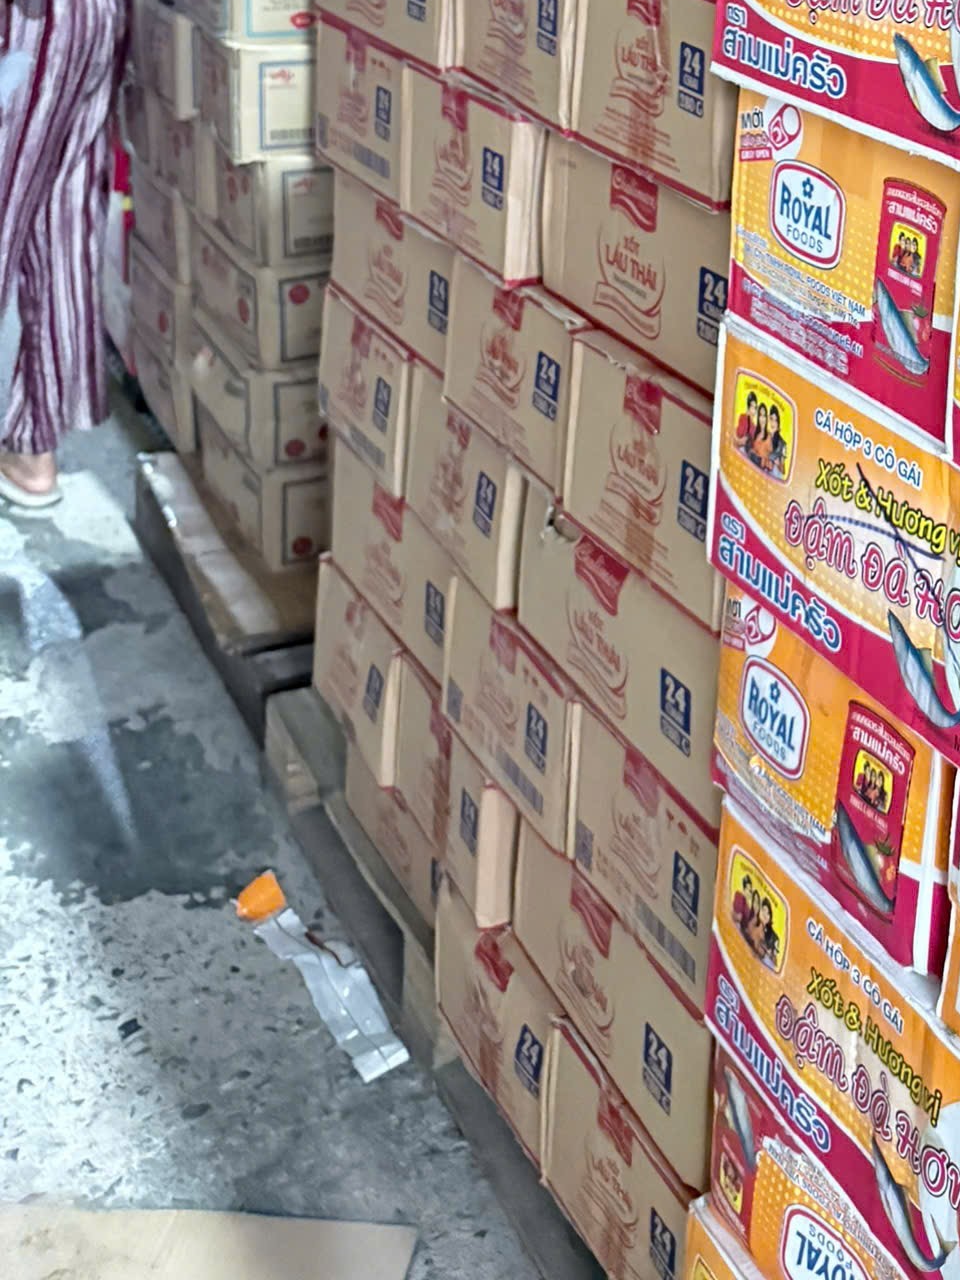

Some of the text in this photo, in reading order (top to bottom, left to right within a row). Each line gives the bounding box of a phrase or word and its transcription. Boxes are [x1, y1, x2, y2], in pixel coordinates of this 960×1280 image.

[726, 5, 747, 24] ตรา
[683, 47, 702, 75] 24
[722, 24, 847, 100] สามแม่ครัว
[485, 152, 501, 176] 24
[779, 176, 833, 240] ROYAL
[785, 225, 824, 253] FOODS
[702, 273, 726, 303] 24
[539, 356, 557, 382] 24
[815, 410, 922, 487] CÁ HỘP 3 CÔ GÁI
[683, 466, 706, 496] 24
[816, 459, 855, 503] Xốt
[854, 483, 872, 510] &
[875, 488, 947, 554] Hương
[721, 513, 746, 542] ตรา
[719, 535, 841, 653] สามแม่ครัว
[664, 674, 687, 703] 24
[748, 677, 796, 753] ROYAL
[675, 856, 697, 885] 24
[807, 920, 905, 1034] CÁ HỘP 3 CÔ GÁI
[807, 967, 843, 1019] Xốt
[842, 1001, 863, 1032] &
[647, 1029, 671, 1059] 24
[715, 993, 832, 1153] สามแม่ครัว
